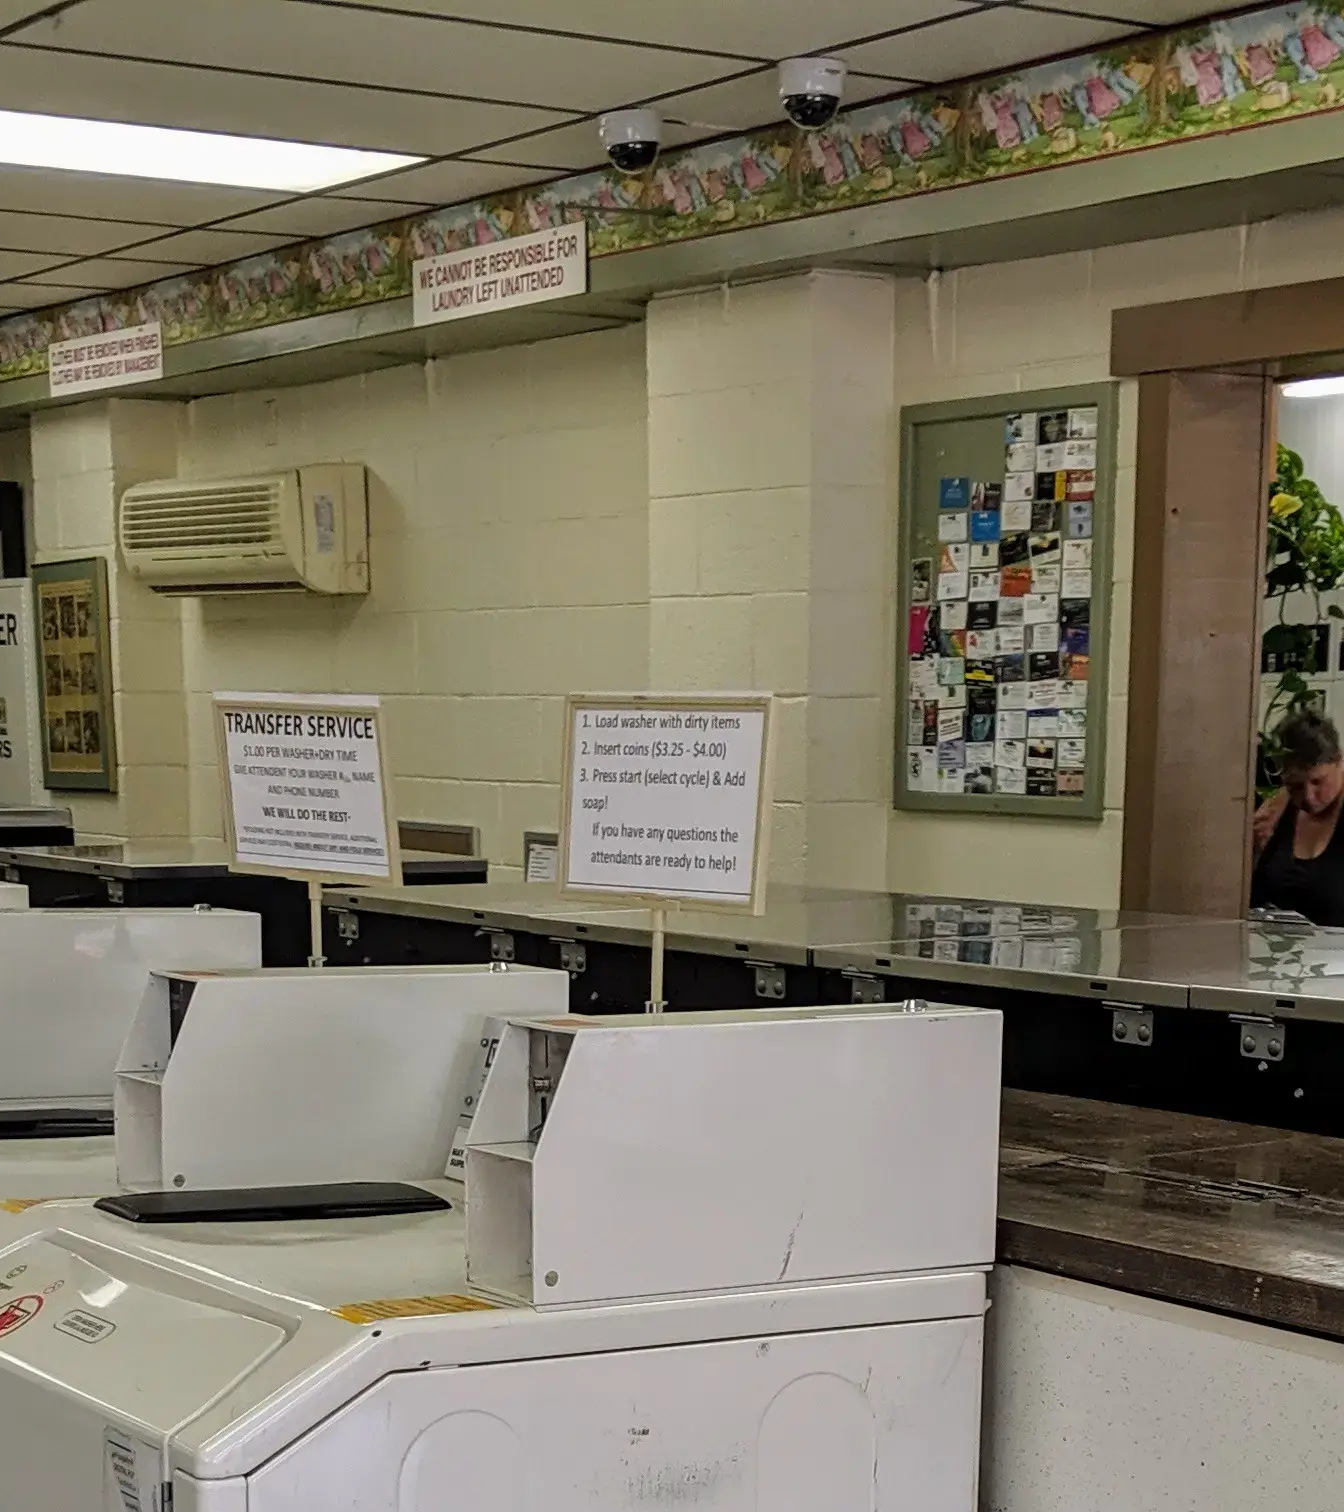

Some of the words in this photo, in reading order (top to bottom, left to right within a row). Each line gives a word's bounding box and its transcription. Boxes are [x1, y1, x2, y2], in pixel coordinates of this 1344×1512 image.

[420, 268, 433, 289] WE
[436, 260, 472, 286] CANNOT
[475, 257, 487, 277] BE
[489, 241, 554, 273] RESPONSIBLE
[557, 235, 577, 258] FOR
[432, 287, 473, 311] LAUNDRY
[476, 280, 498, 302] LEFT
[501, 266, 563, 297] UNATTENDED
[225, 712, 303, 736] TRANSFER
[307, 716, 374, 739] SERVICE
[582, 714, 592, 728] 1.
[595, 714, 618, 728] Load
[621, 715, 657, 729] washer
[659, 714, 682, 729] with
[684, 714, 709, 732] dirty
[710, 716, 741, 729] items
[243, 745, 265, 758] $1.00
[266, 746, 281, 758] PER
[335, 750, 358, 763] TIME
[581, 741, 590, 755] 2.
[593, 741, 621, 755] Insert
[623, 742, 649, 757] coins
[651, 741, 684, 759] ($3.25
[692, 741, 727, 760] $4.00)
[352, 772, 376, 784] NAME
[579, 768, 589, 782] 3.
[592, 768, 617, 783] Press
[619, 770, 641, 784] start
[644, 770, 678, 786] (select
[680, 770, 710, 788] cycle)
[712, 772, 721, 786] &
[723, 771, 746, 786] Add
[582, 796, 608, 812] soap!
[261, 806, 276, 818] WE
[277, 807, 296, 820] WILL
[297, 809, 311, 820] DO
[311, 809, 327, 822] THE
[592, 822, 600, 836] If
[601, 825, 619, 840] you
[621, 823, 644, 839] have
[646, 828, 664, 842] any
[667, 827, 717, 842] questions
[720, 828, 739, 843] the
[590, 850, 642, 866] attendants
[645, 854, 661, 867] are
[663, 853, 692, 872] ready
[694, 855, 706, 869] to
[709, 855, 737, 873] help!
